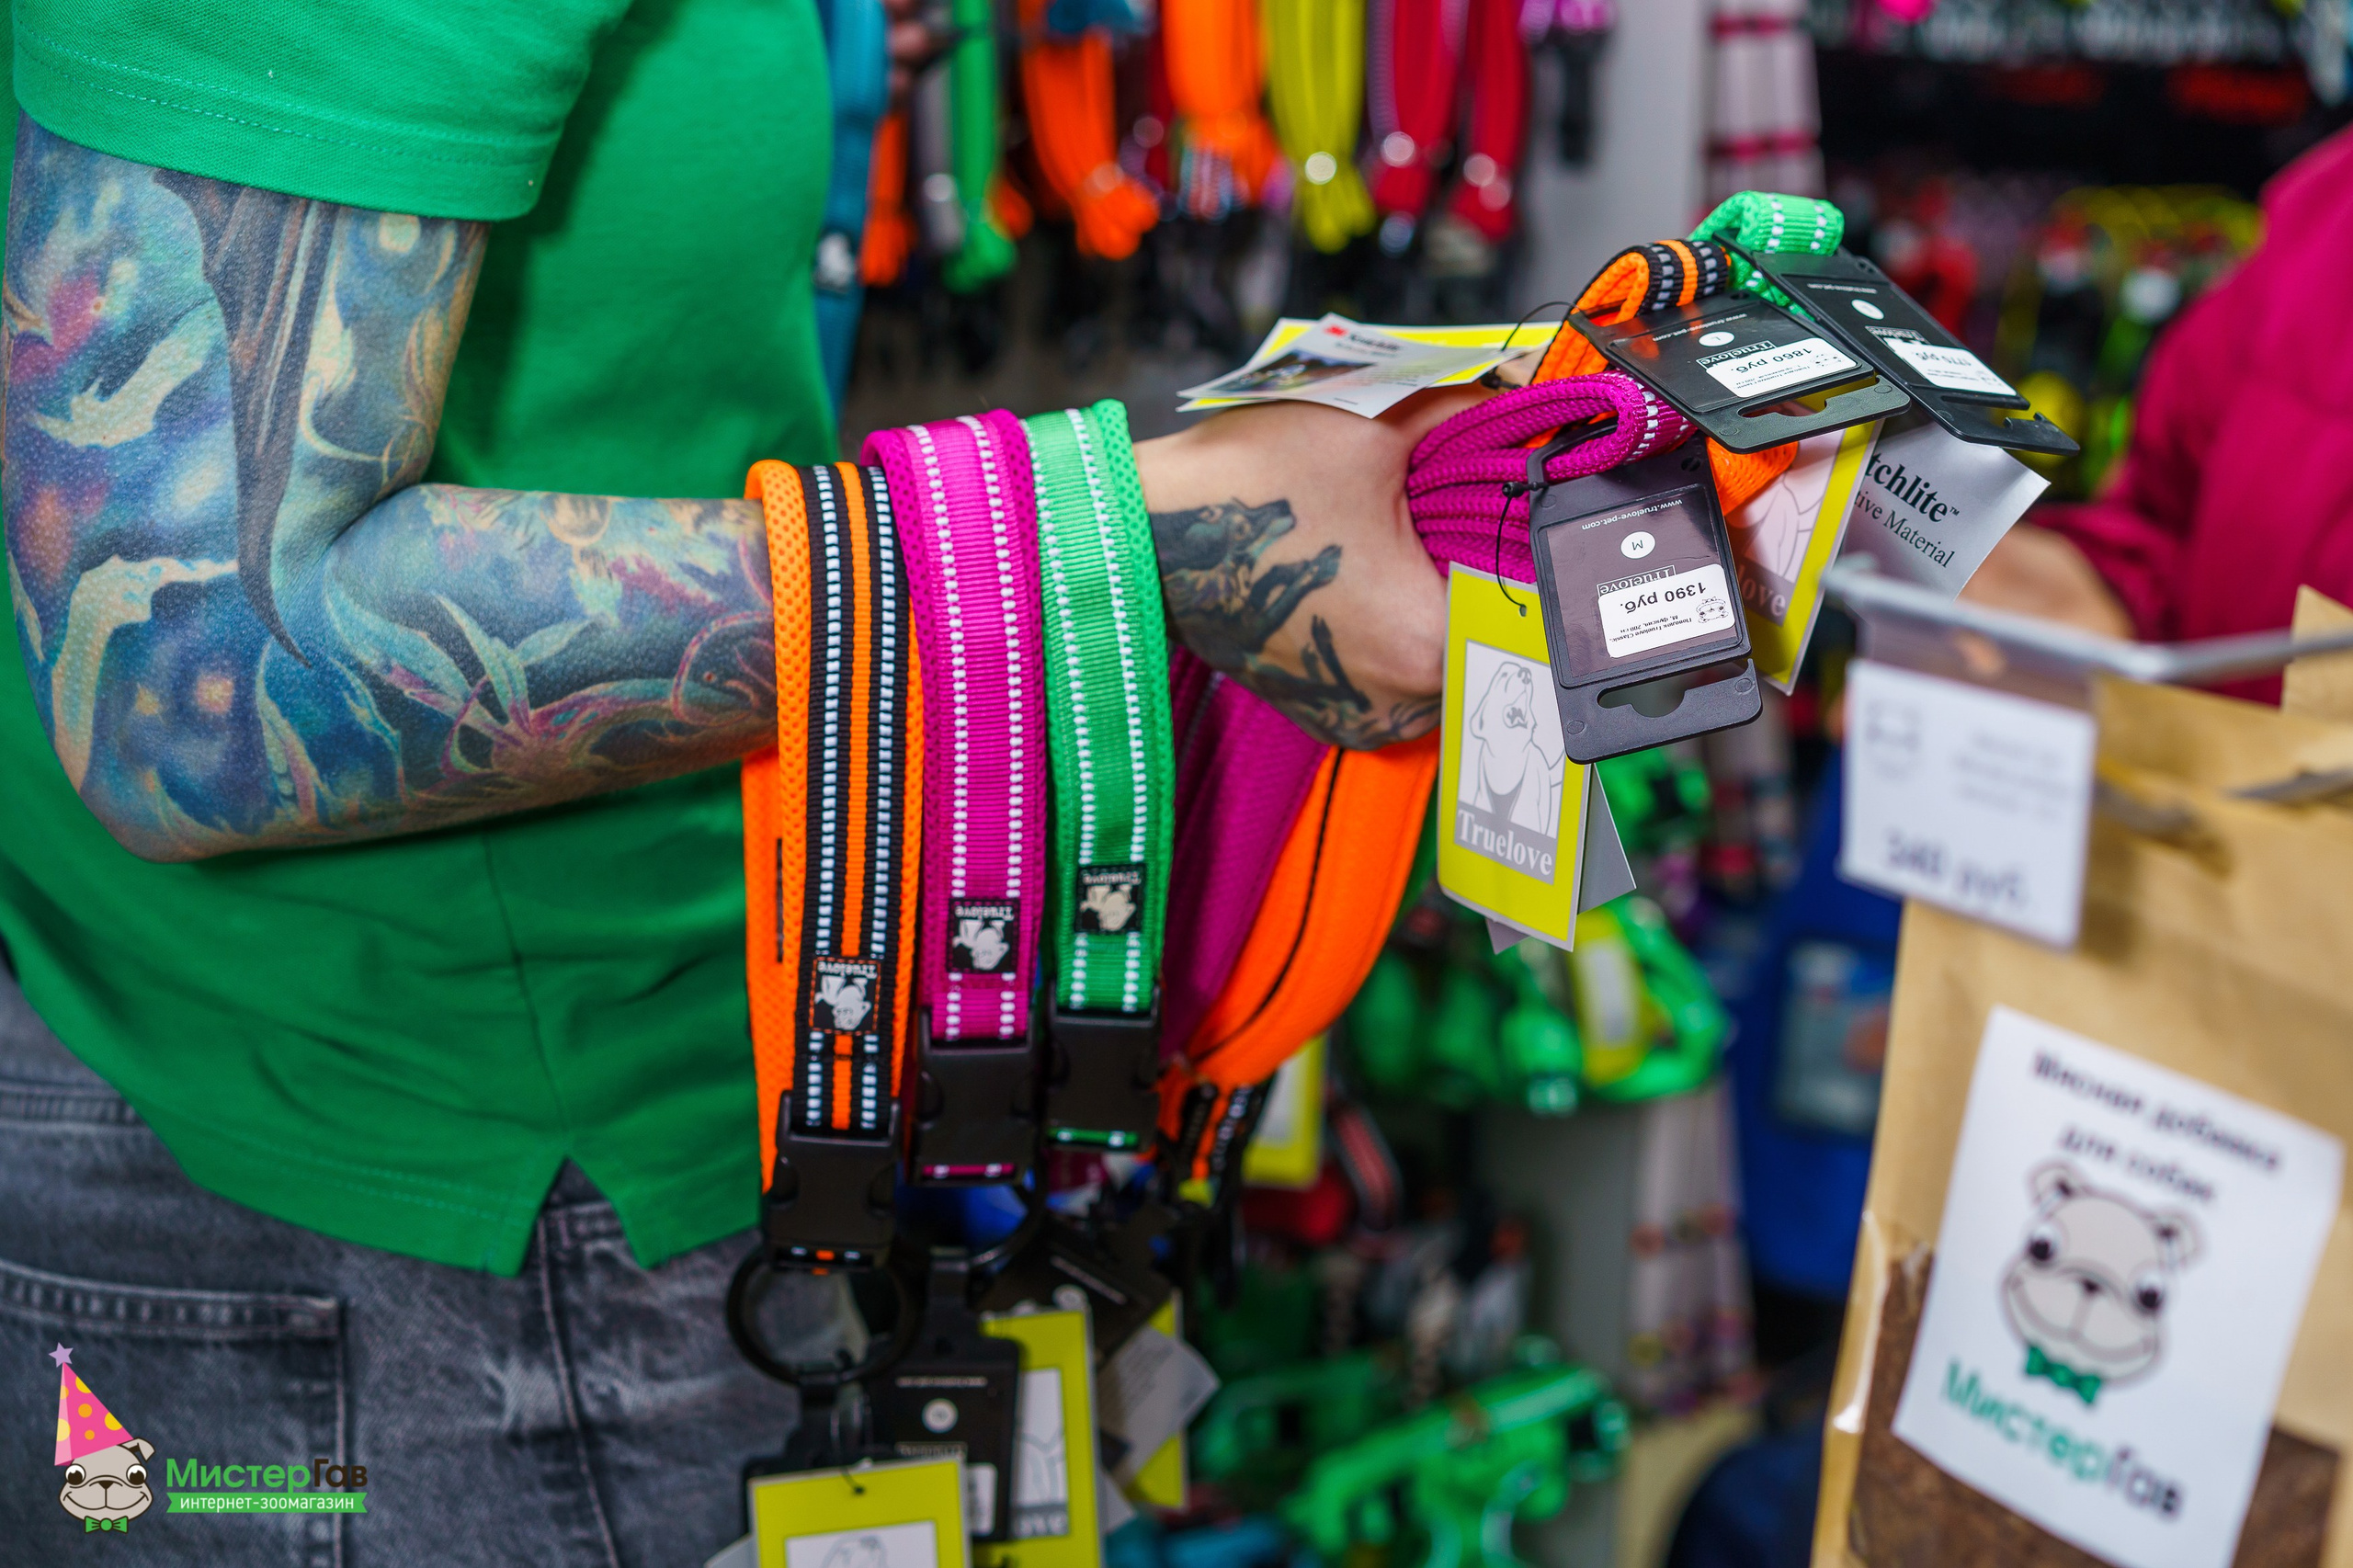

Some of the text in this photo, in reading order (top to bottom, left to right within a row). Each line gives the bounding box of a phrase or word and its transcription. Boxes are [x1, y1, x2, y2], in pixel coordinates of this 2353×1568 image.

[1653, 313, 1747, 341] www.truelove-pet.com
[1700, 342, 1774, 365] Truelove
[1731, 347, 1812, 374] 1860 руб.
[1582, 498, 1683, 530] www.truelove-pet.com
[1631, 540, 1643, 551] M
[1883, 509, 1955, 568] Material
[1599, 568, 1673, 595] Truelove
[1620, 582, 1707, 613] 1390 руб.
[1457, 808, 1552, 876] Truelove
[1082, 871, 1142, 886] Truelove
[954, 905, 1014, 922] Truelove
[817, 960, 878, 979] Truelove
[1943, 1355, 2184, 1520] МистерГав
